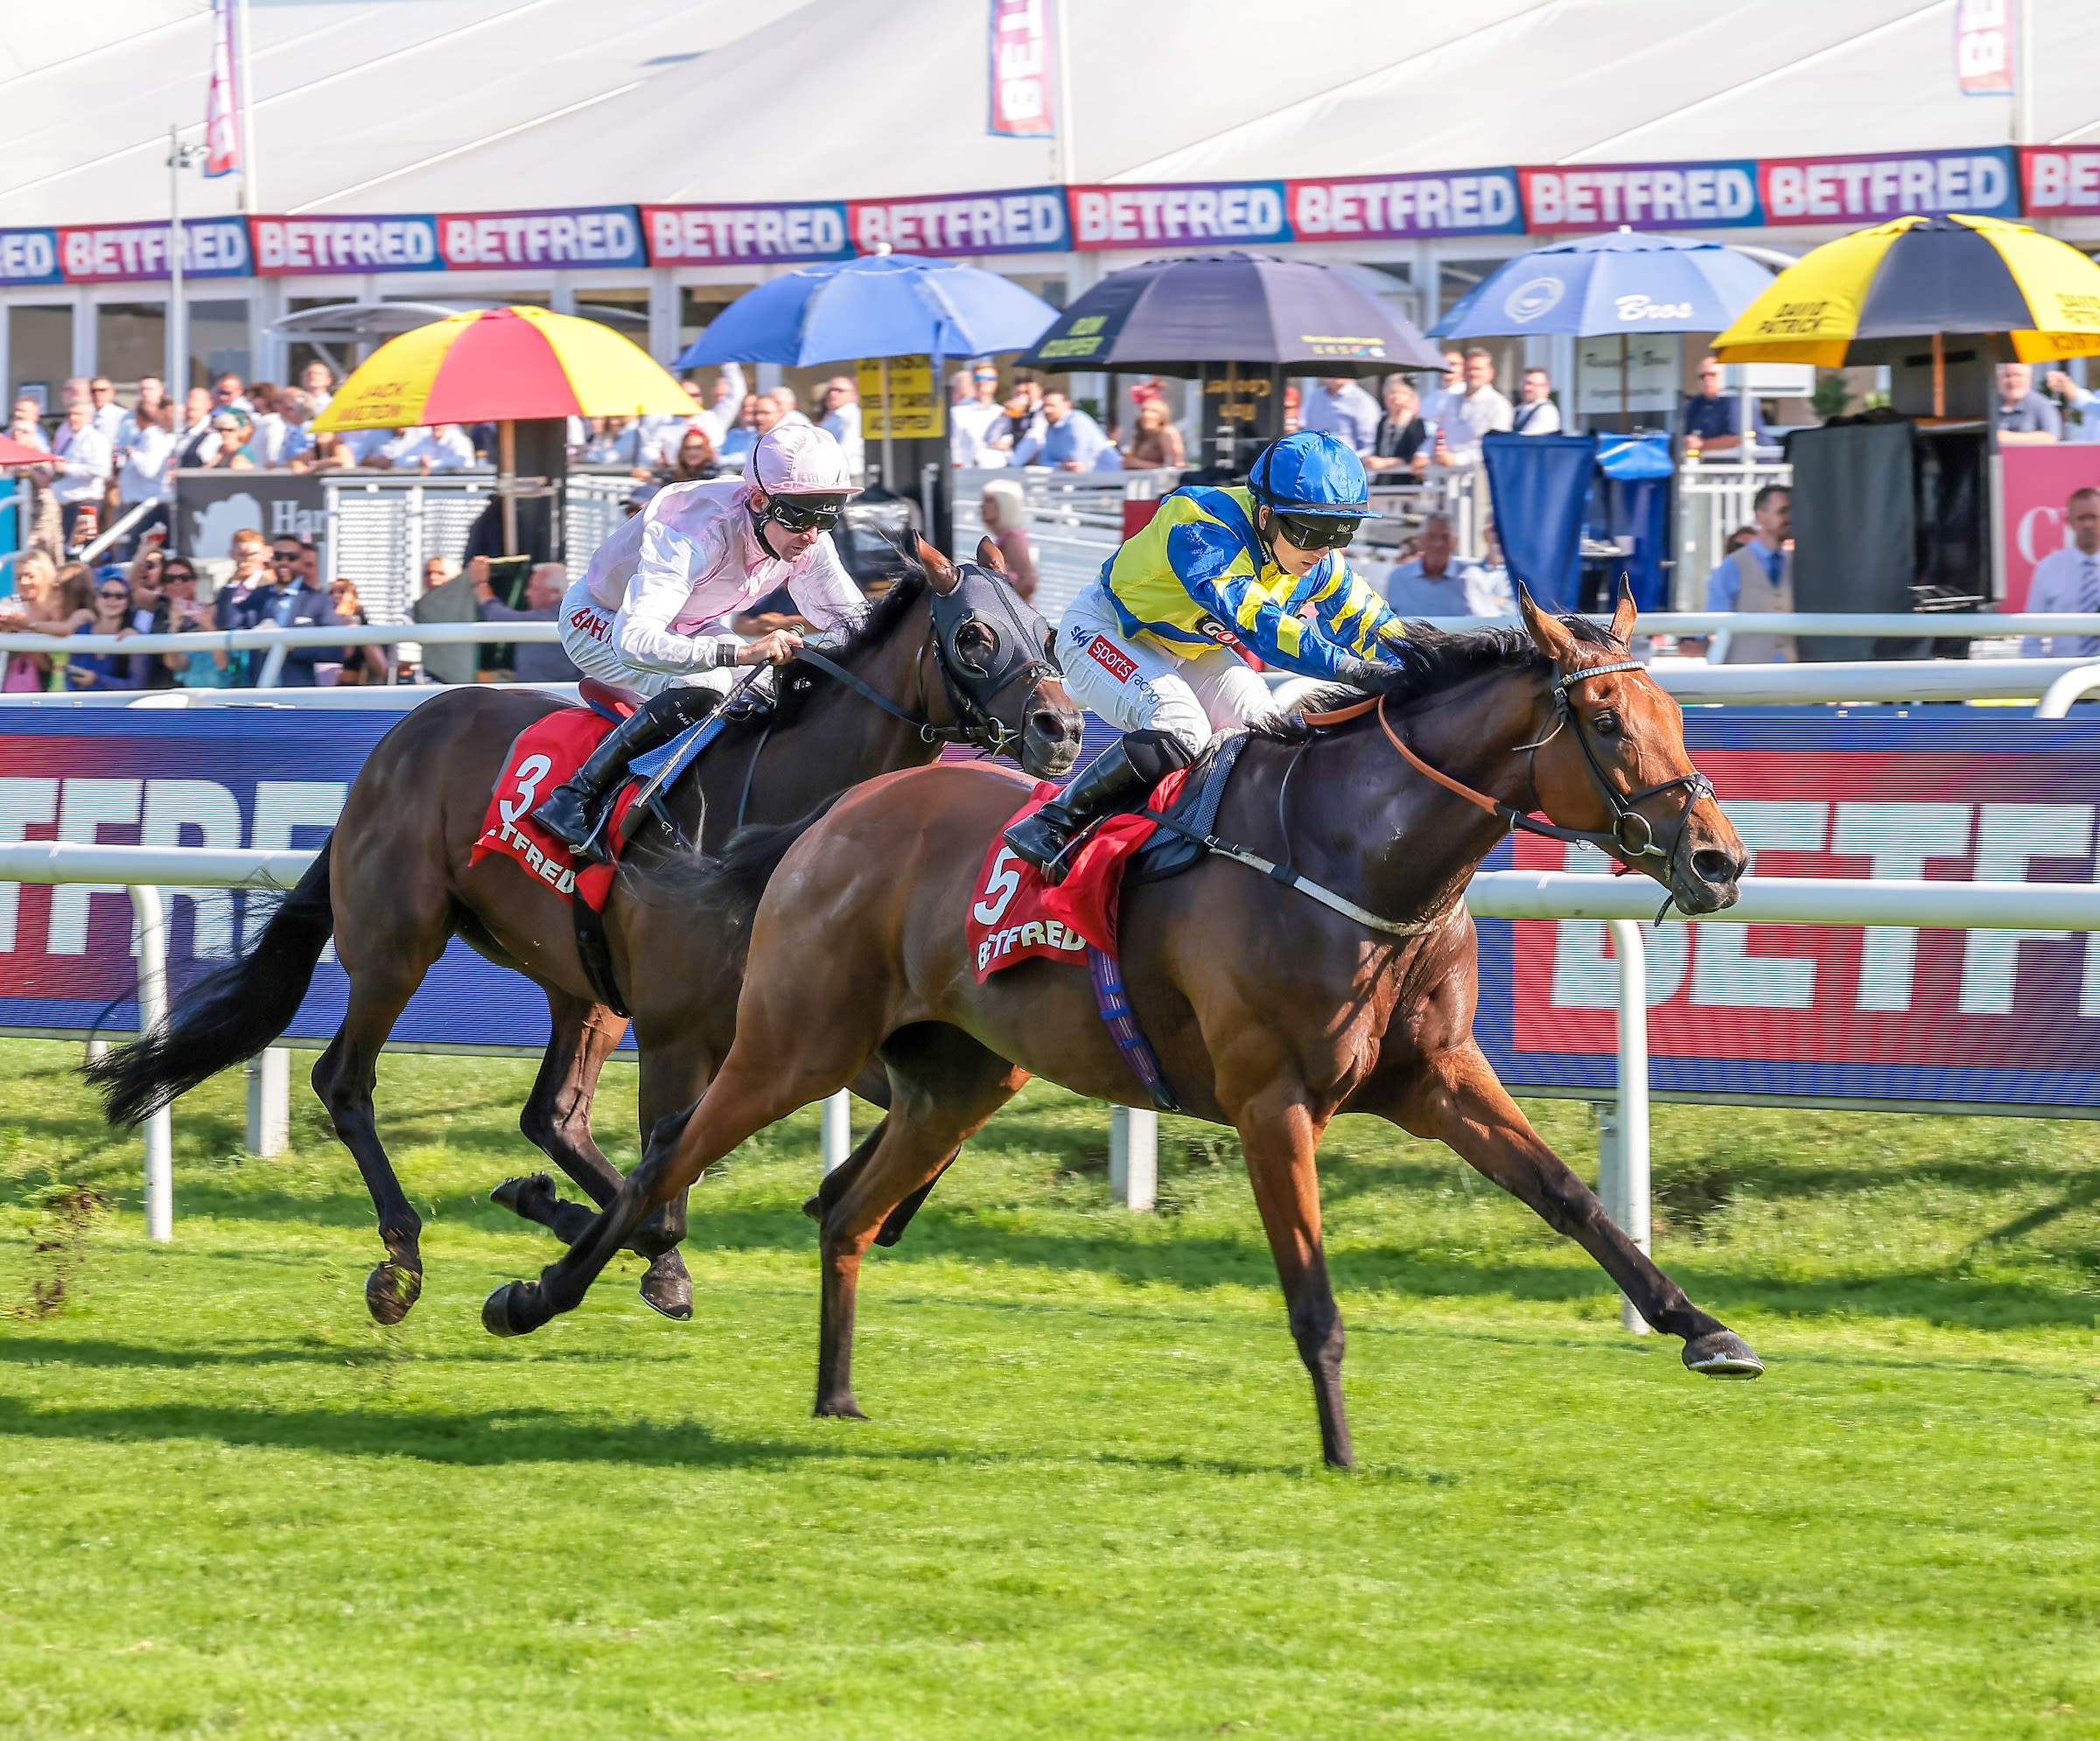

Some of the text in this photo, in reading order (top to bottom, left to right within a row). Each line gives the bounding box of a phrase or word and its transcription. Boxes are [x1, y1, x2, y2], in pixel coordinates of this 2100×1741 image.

[1296, 175, 1518, 232] BETFRED
[1530, 169, 1754, 224] BETFRED
[1768, 156, 2010, 215] BETFRED
[260, 221, 434, 264] BETFRED
[447, 213, 637, 263] BETFRED
[653, 208, 844, 258] BETFRED
[858, 194, 1065, 251] BETFRED
[1078, 188, 1284, 241] BETFRED
[64, 223, 248, 276] BETFRED
[1614, 294, 1694, 321] Bros
[1070, 626, 1162, 705] sky sports racing
[500, 754, 552, 822] 3
[973, 845, 1020, 926] 5
[1550, 801, 2100, 1018] BETF
